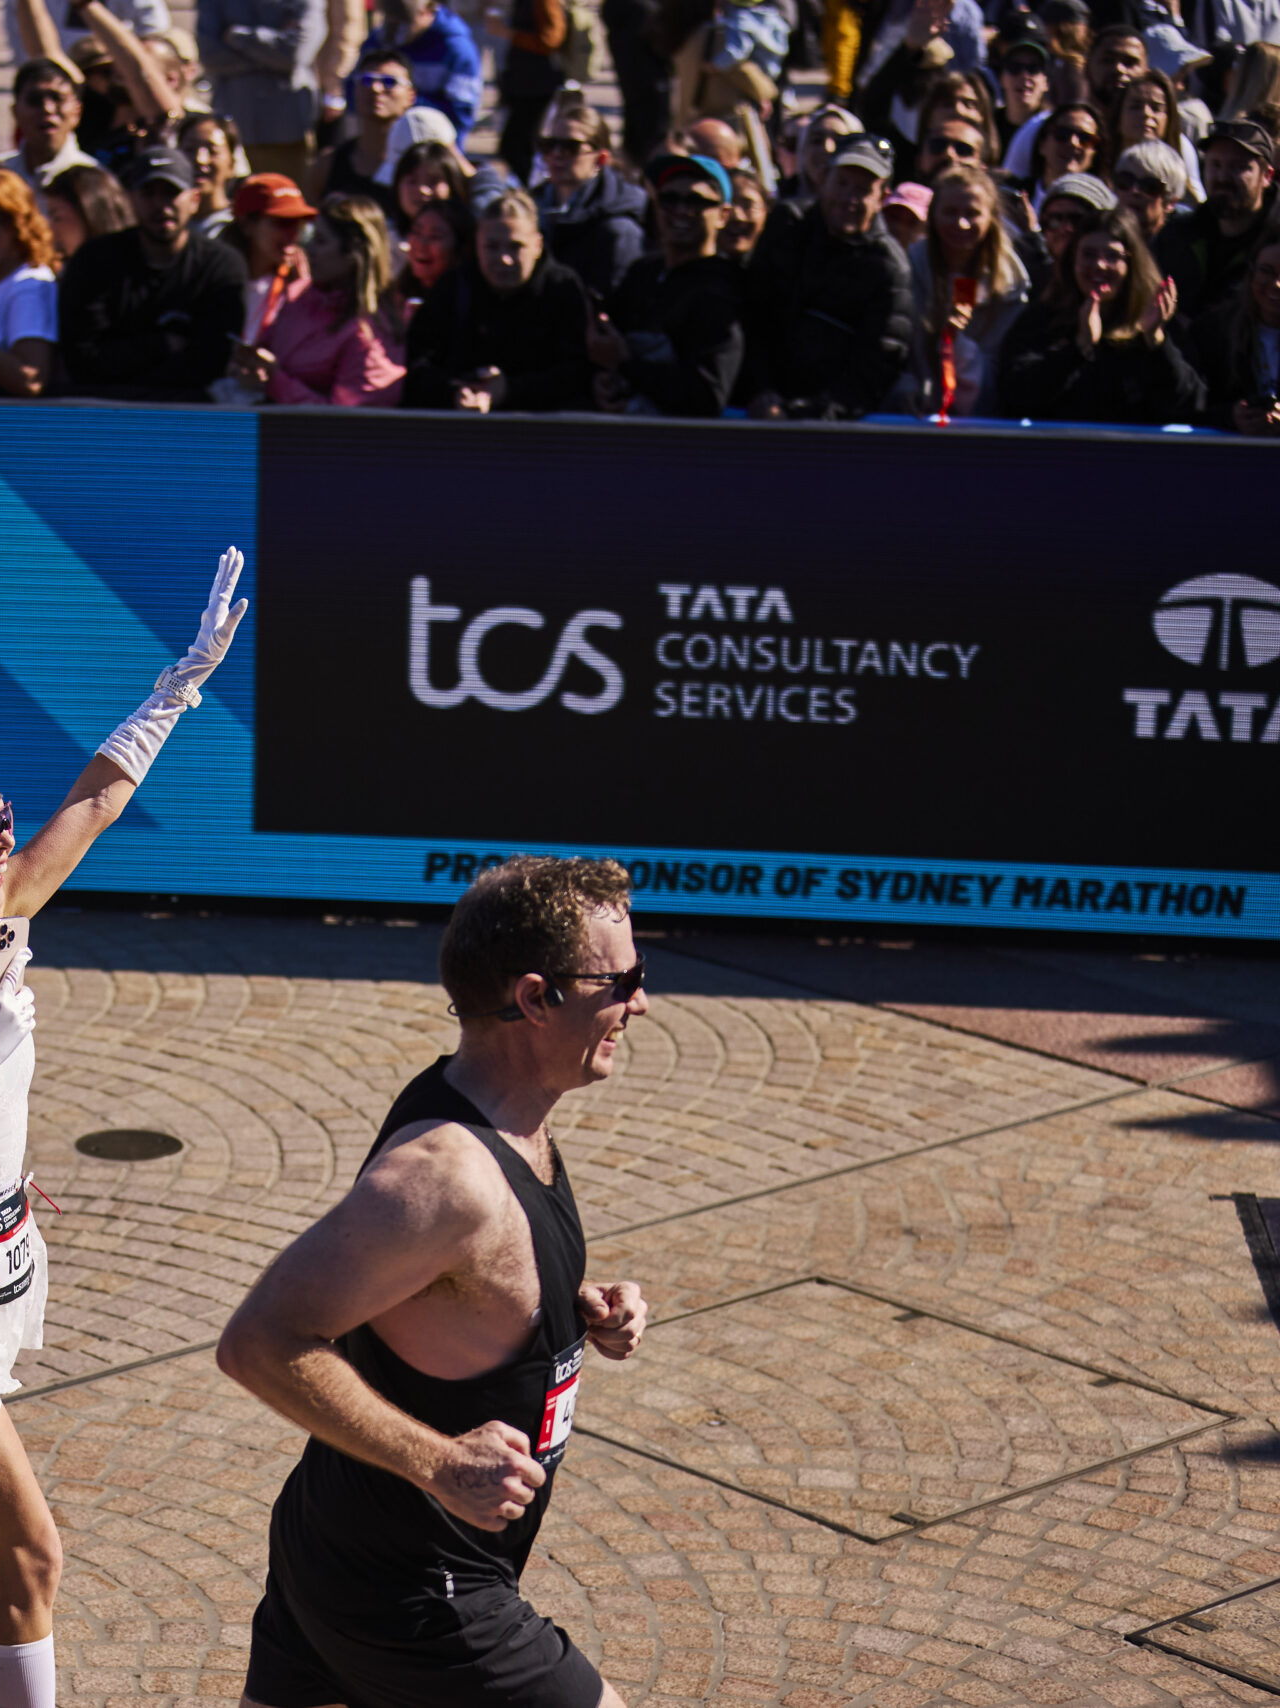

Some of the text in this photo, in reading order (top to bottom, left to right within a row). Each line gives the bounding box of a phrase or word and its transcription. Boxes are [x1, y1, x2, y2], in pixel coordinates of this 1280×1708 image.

[658, 583, 794, 622] TATA
[409, 576, 623, 715] tcs
[655, 632, 980, 679] CONSULTANCY
[654, 681, 858, 724] SERVICES
[773, 864, 829, 900] OF
[835, 868, 1003, 907] SYDNEY
[1012, 875, 1247, 919] MARATHON
